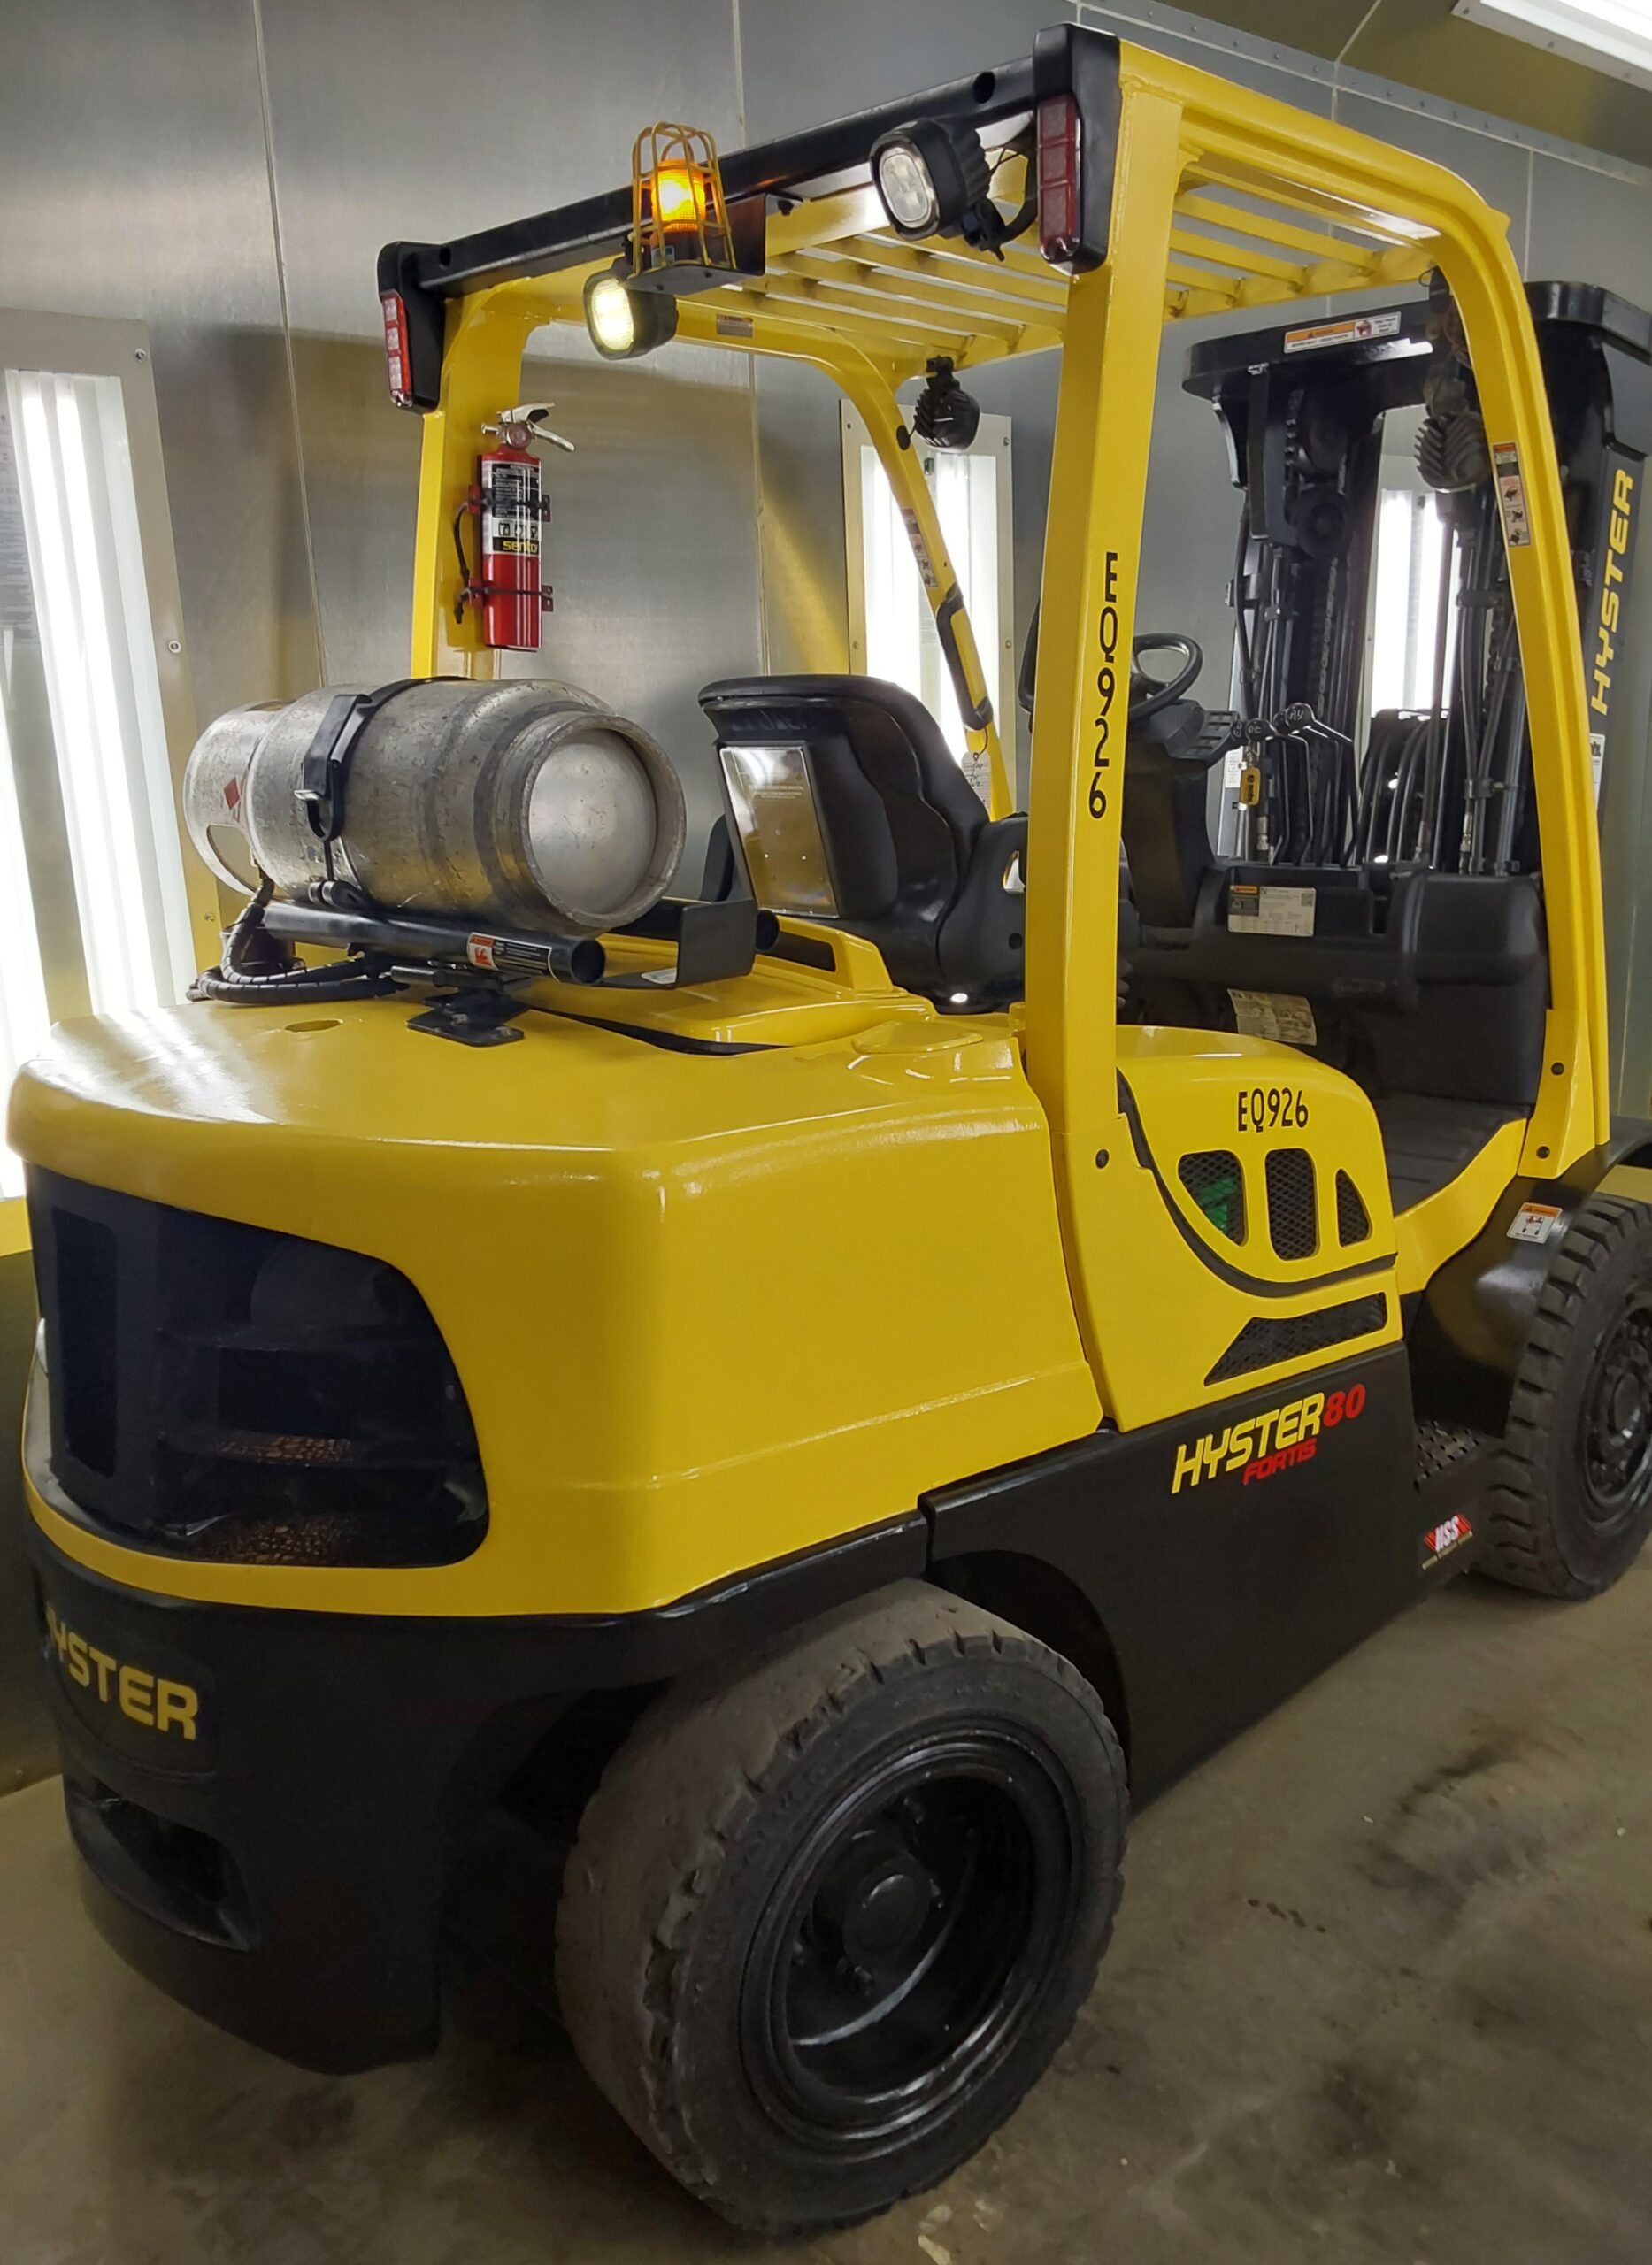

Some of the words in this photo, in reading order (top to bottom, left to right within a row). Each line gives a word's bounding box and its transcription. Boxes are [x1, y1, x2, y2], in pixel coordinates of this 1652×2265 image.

[1591, 468, 1634, 716] HYSTER
[1088, 551, 1118, 819] EQ926
[1238, 1086, 1309, 1133] EQ926
[1171, 1392, 1325, 1494] HYSTER
[1323, 1383, 1366, 1427] 80
[1241, 1437, 1318, 1486] FORTIS
